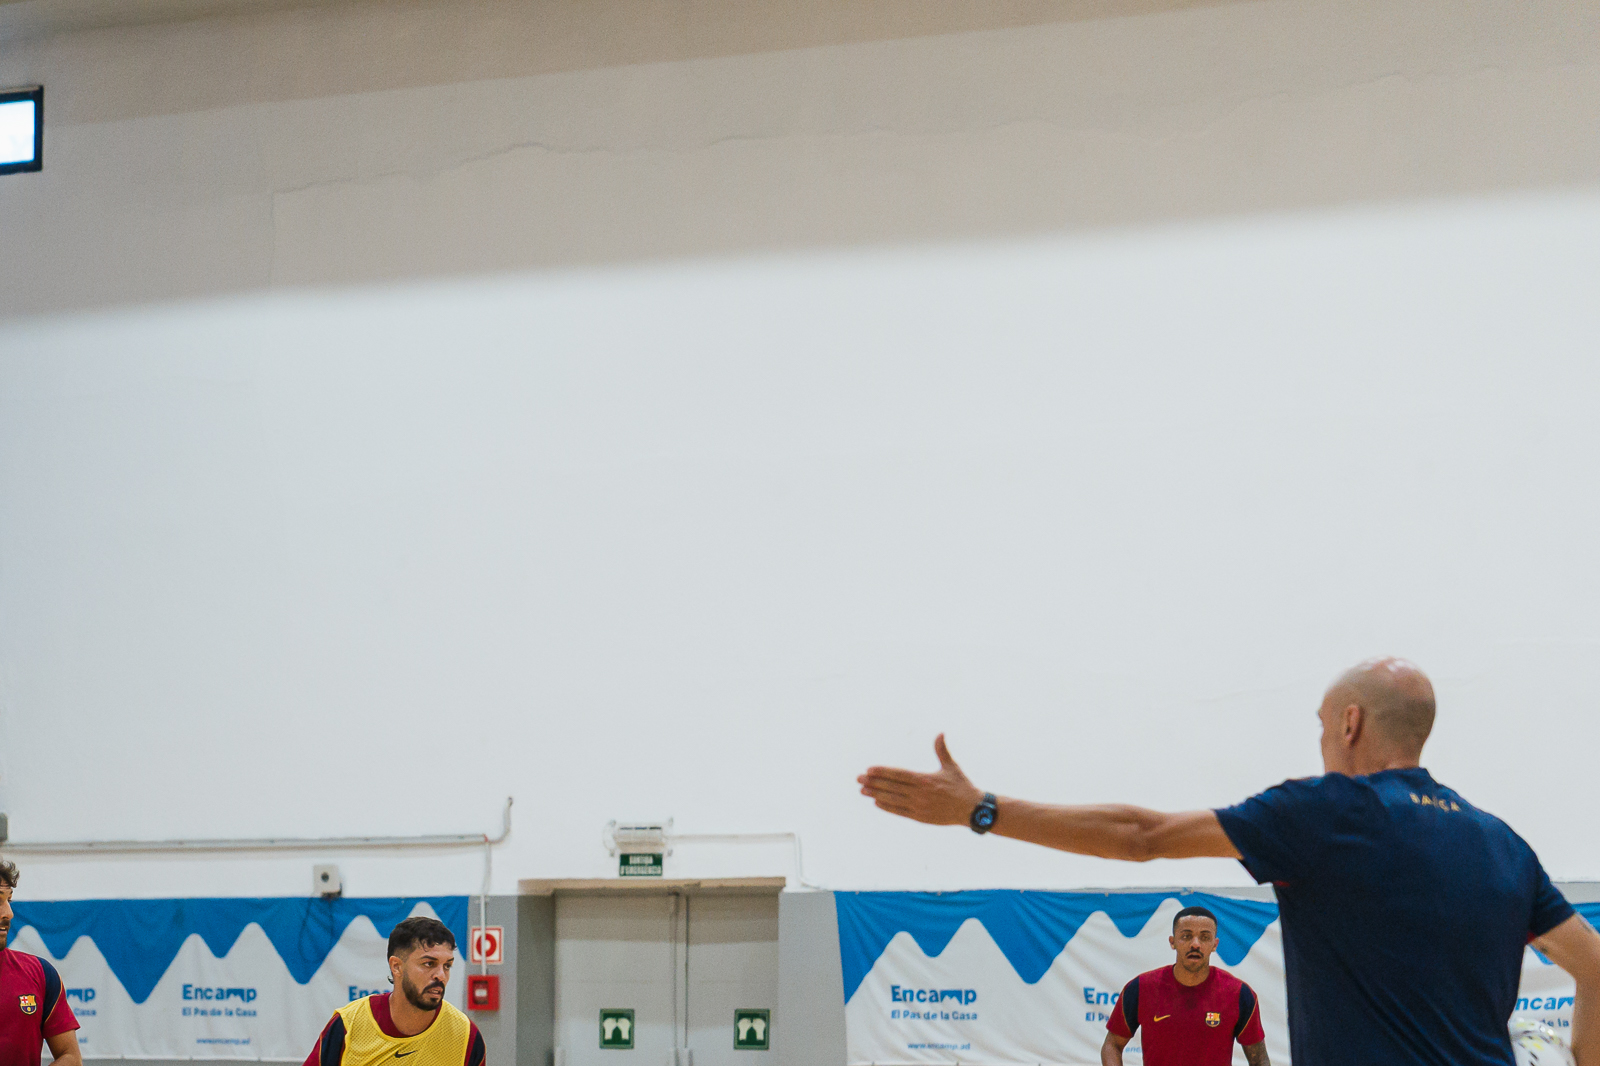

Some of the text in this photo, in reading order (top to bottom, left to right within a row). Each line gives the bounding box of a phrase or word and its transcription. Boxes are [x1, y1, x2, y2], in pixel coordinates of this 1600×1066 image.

[182, 984, 257, 1003] Encamp
[891, 985, 977, 1005] Encamp
[1083, 987, 1120, 1005] Enc
[1515, 997, 1575, 1011] ncam
[182, 1007, 191, 1016] El
[225, 1008, 233, 1016] la
[236, 1007, 257, 1017] Casa
[891, 1010, 978, 1020] El Pas de la Casa
[1086, 1012, 1095, 1021] El
[1557, 1018, 1570, 1027] la
